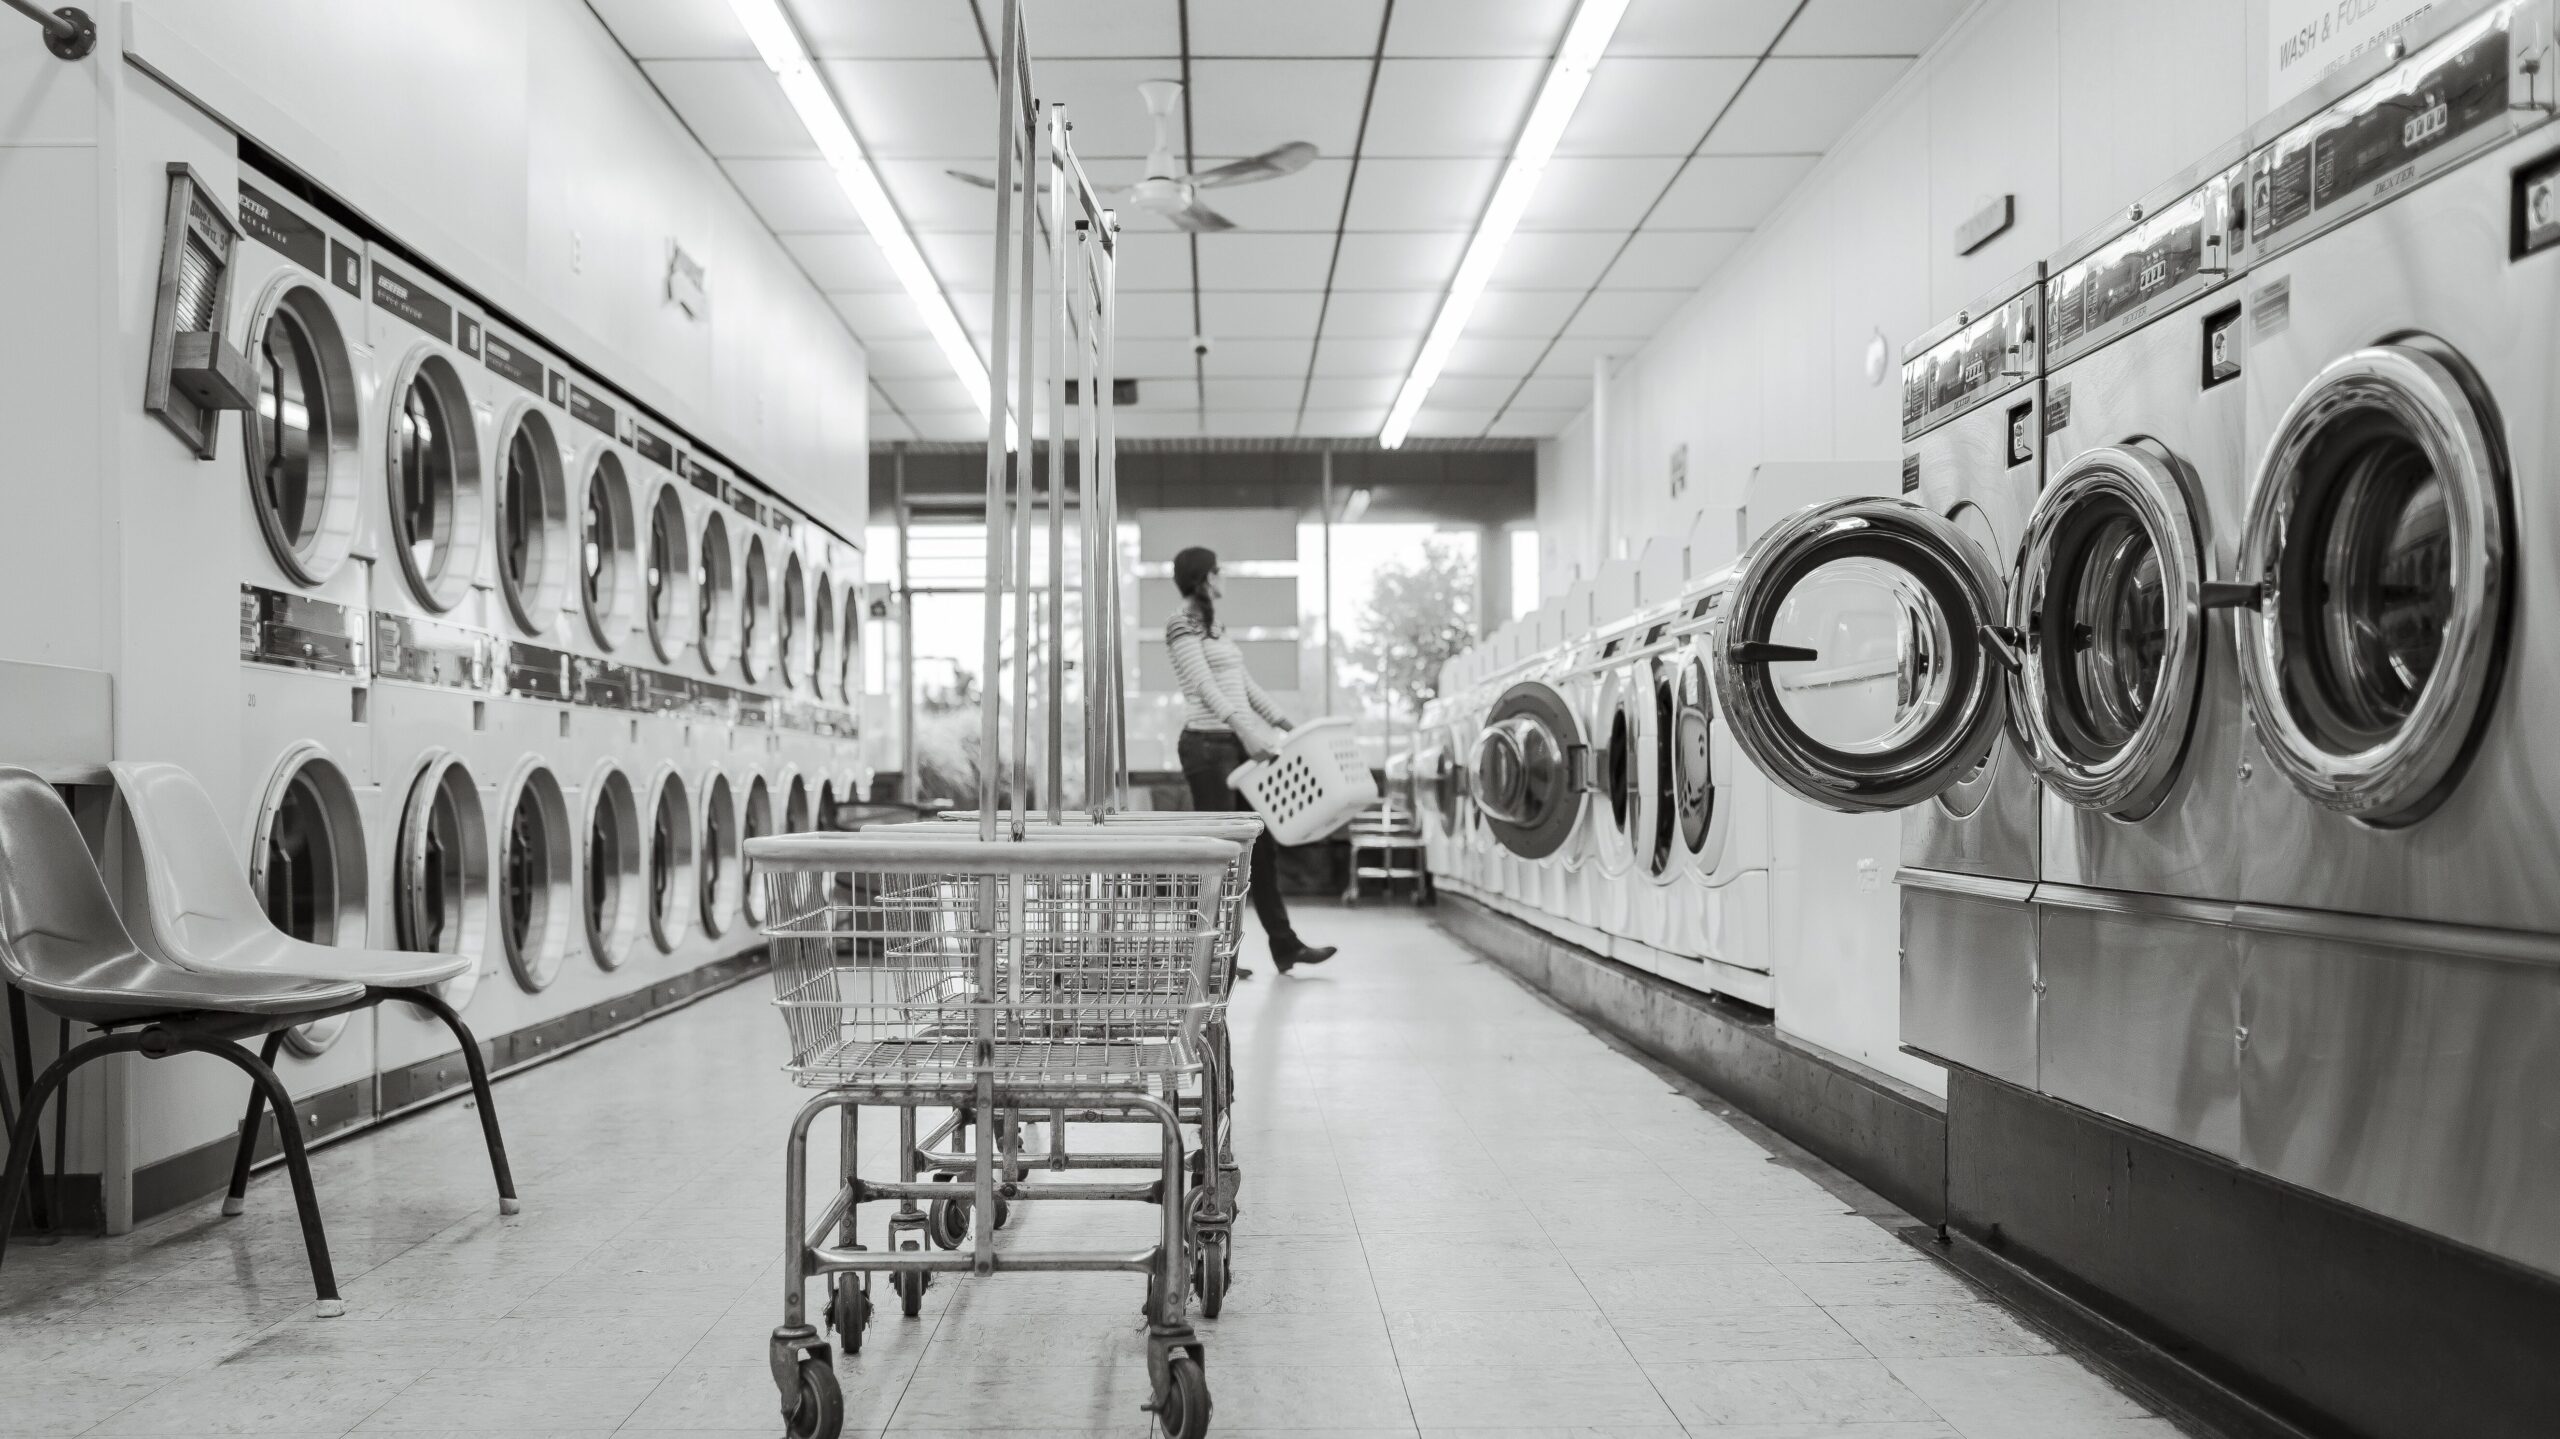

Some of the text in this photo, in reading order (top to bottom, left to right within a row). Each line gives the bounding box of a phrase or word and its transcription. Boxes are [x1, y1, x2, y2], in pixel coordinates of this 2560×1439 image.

[2280, 20, 2317, 72] WASH
[2321, 12, 2331, 42] &
[239, 194, 269, 220] EXTER
[247, 693, 256, 708] 20
